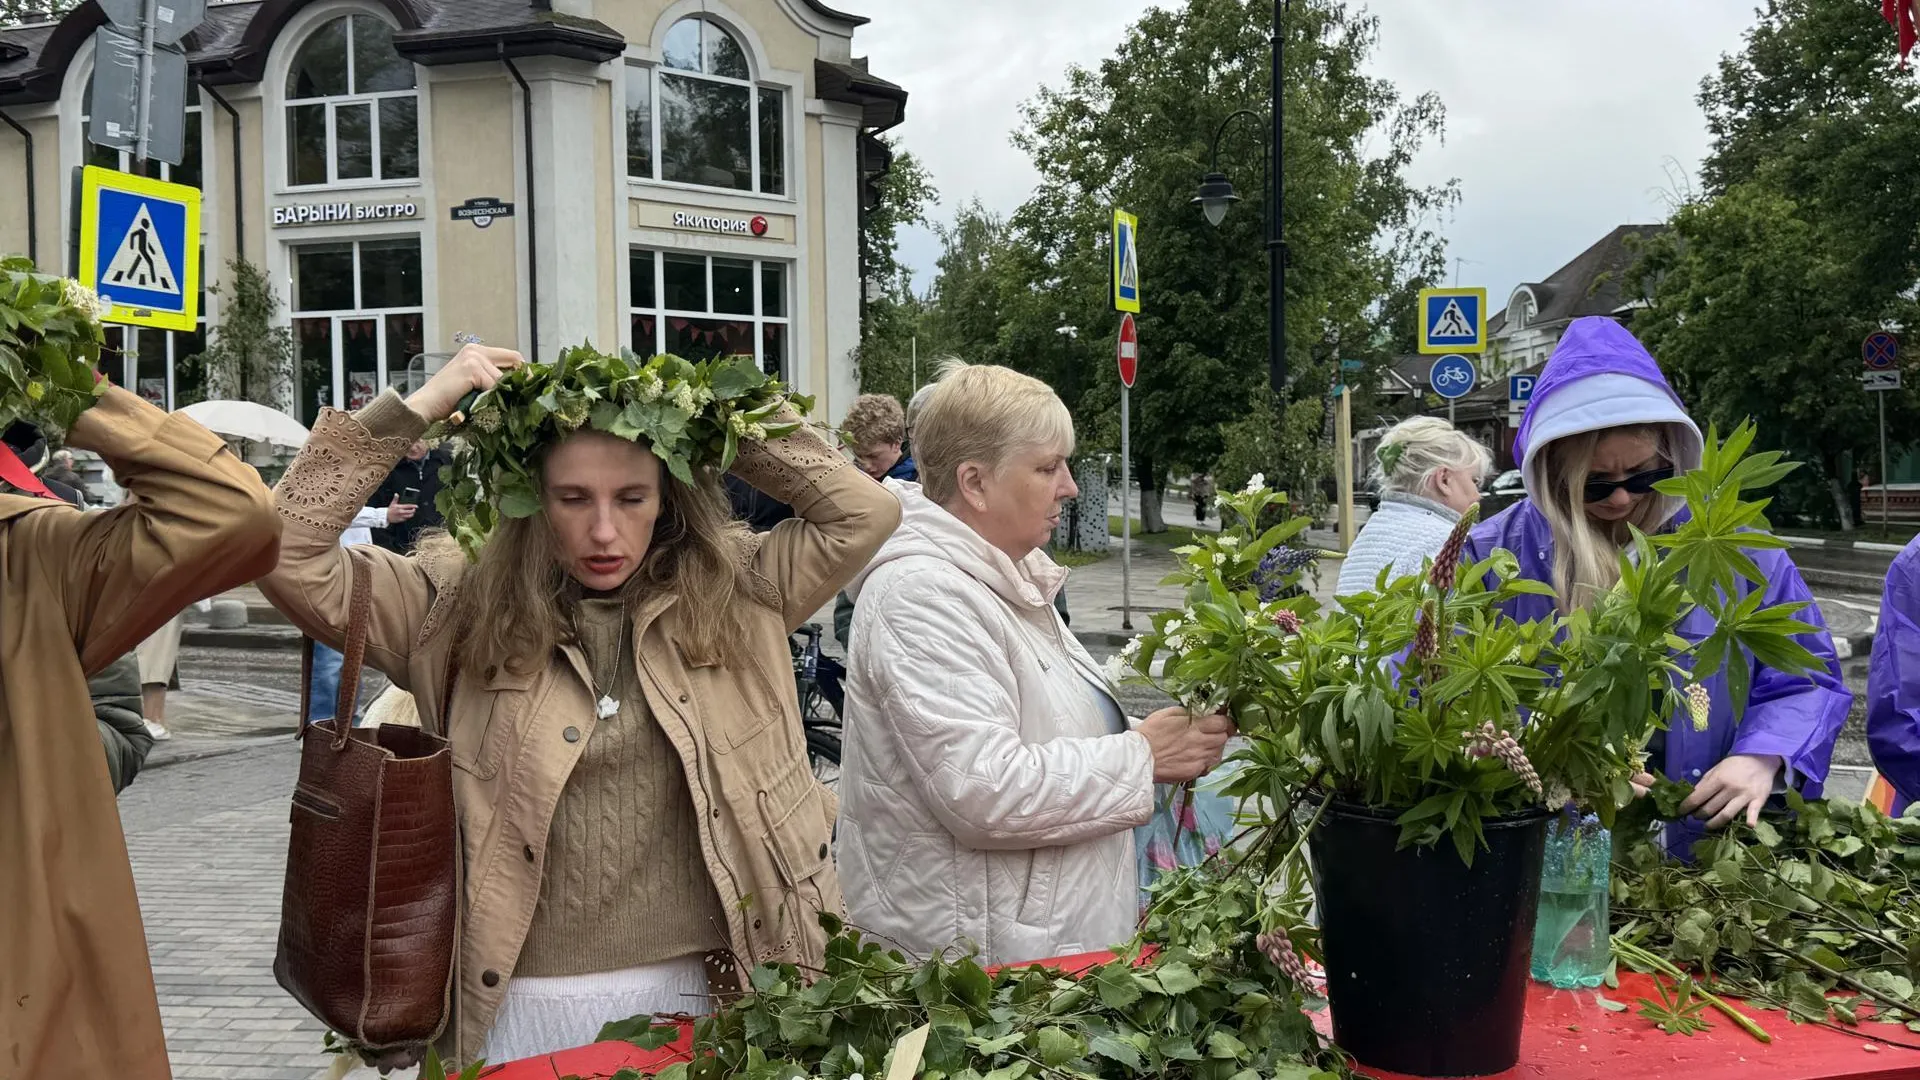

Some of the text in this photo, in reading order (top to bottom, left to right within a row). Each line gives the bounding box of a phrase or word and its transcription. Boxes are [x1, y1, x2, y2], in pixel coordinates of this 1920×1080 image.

[273, 203, 416, 224] БАРЫНИ БИСТРО
[674, 211, 748, 232] Якитория
[1517, 378, 1532, 398] P
